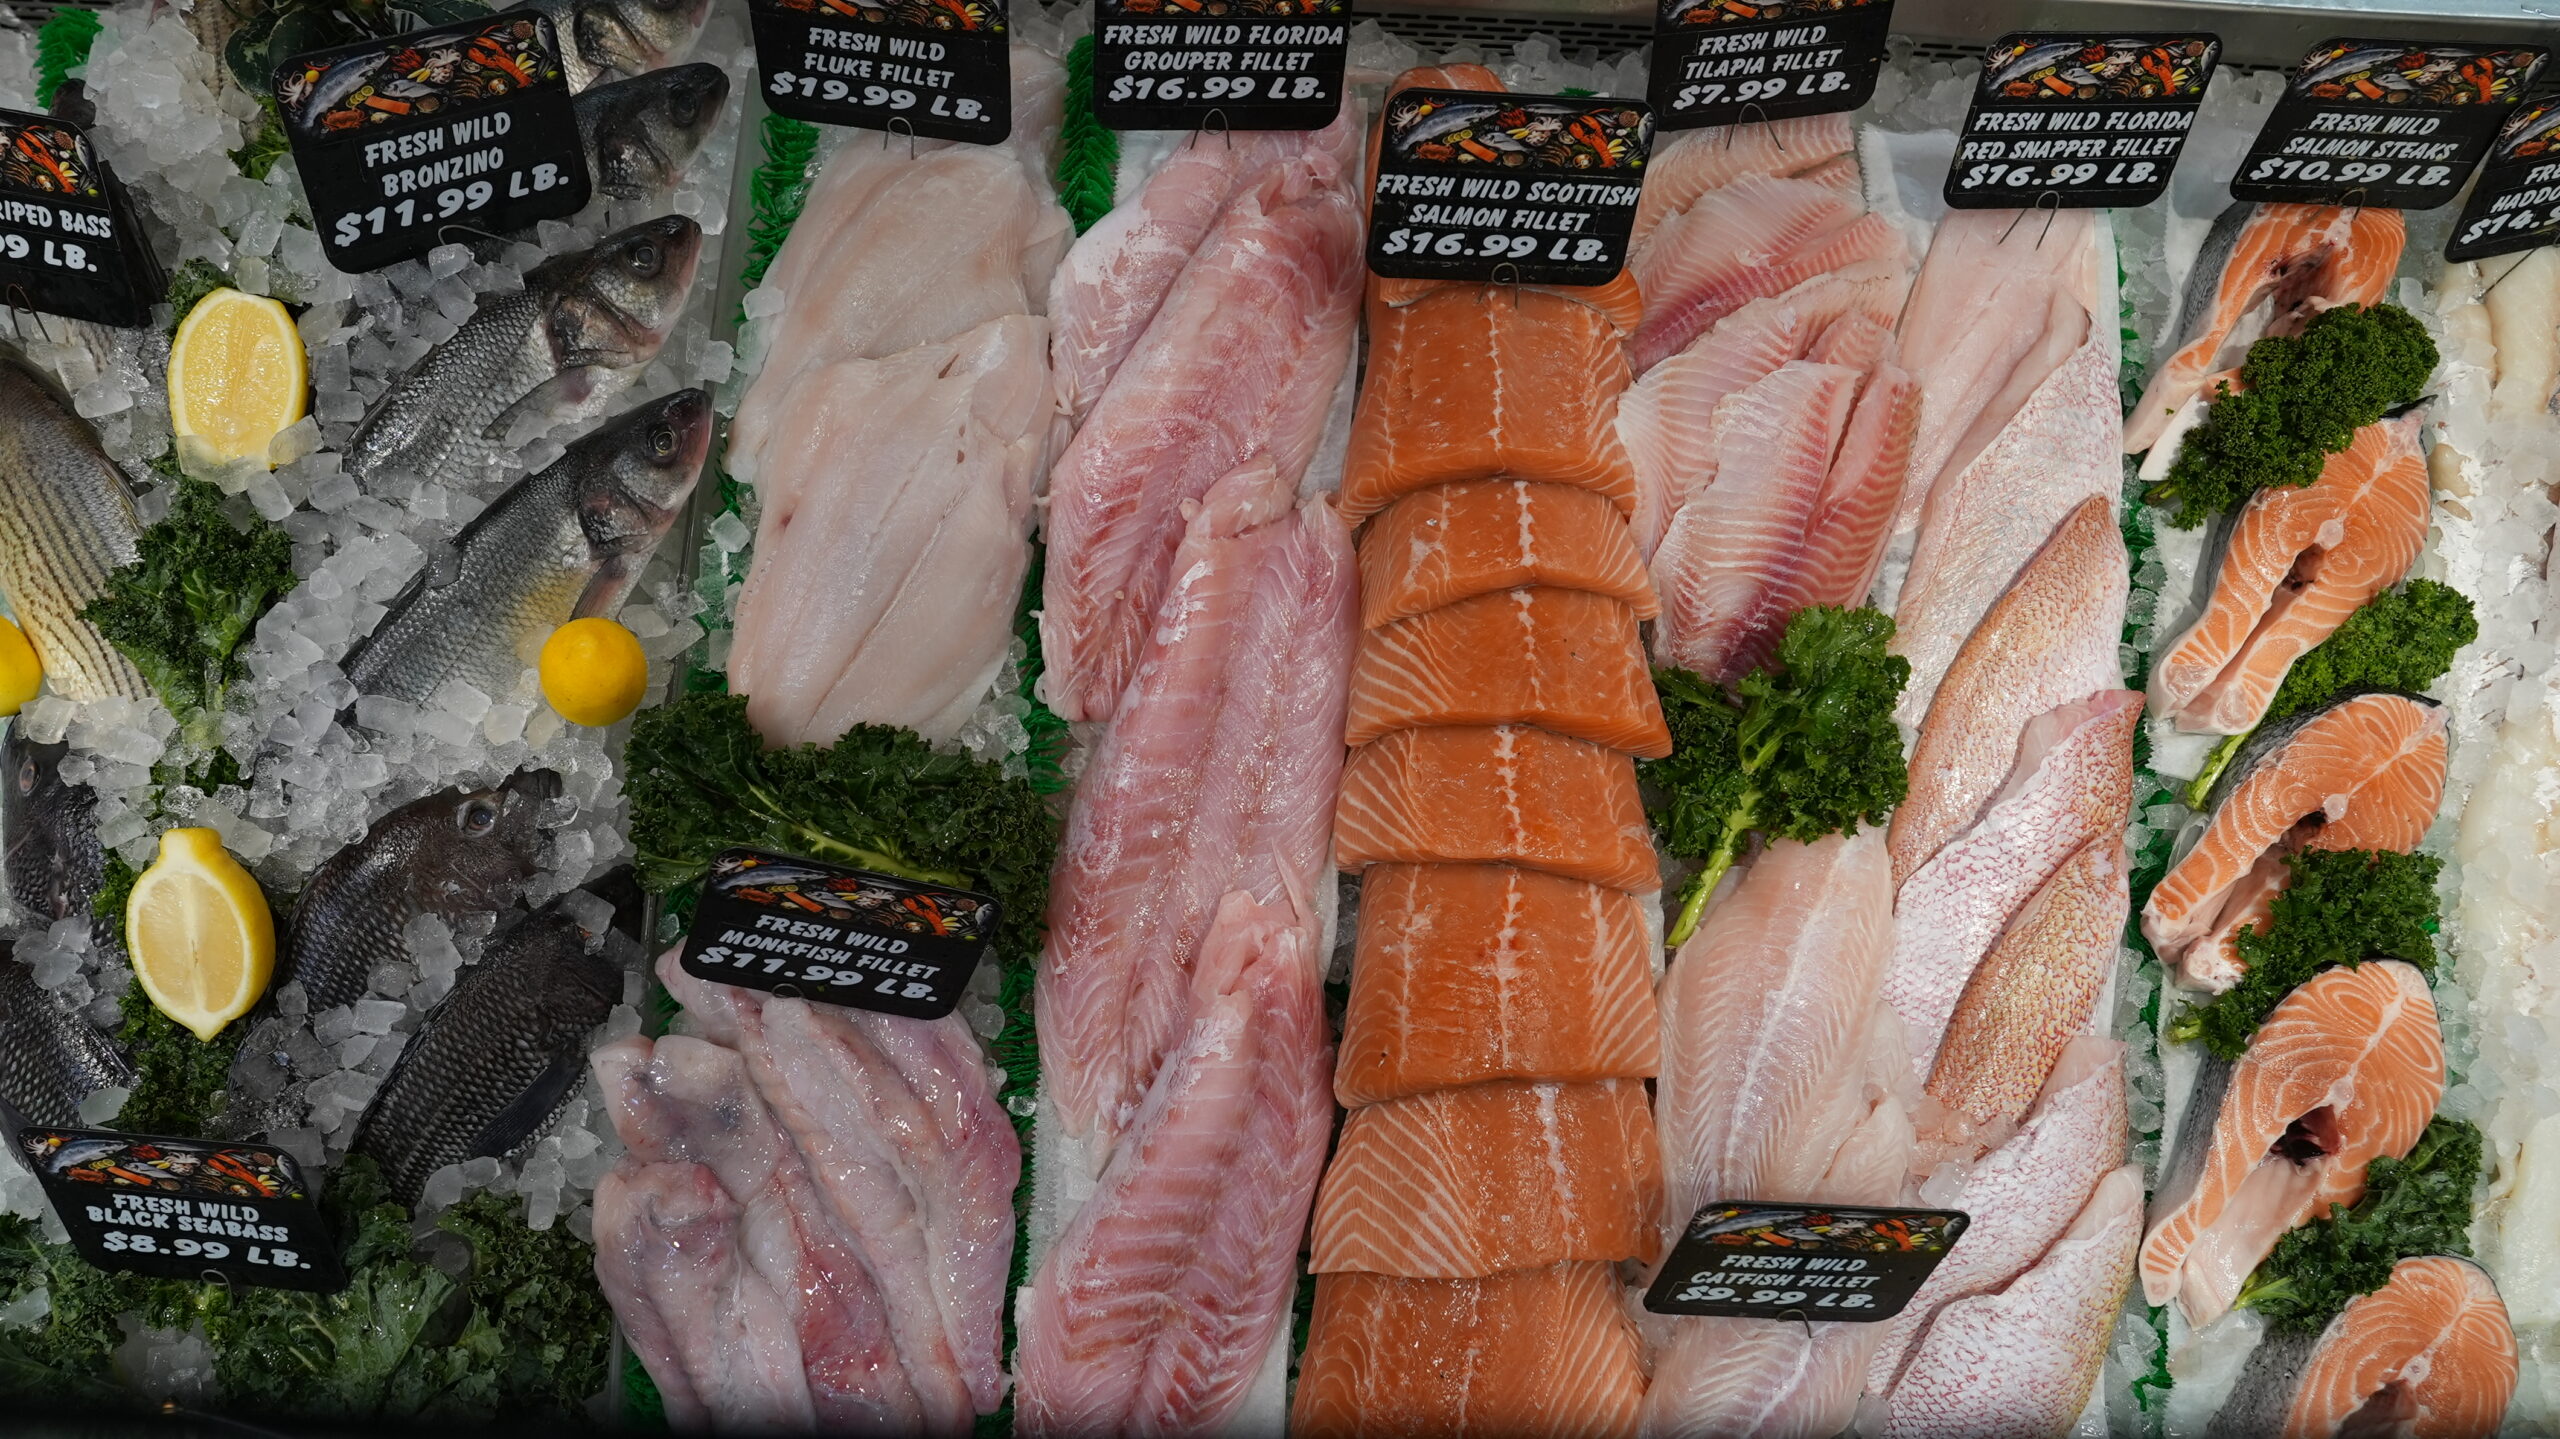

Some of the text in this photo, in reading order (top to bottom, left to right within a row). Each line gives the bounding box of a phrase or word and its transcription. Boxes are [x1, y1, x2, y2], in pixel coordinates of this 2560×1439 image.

[809, 27, 946, 61] FRESH WILD
[1104, 25, 1344, 45] FRESH WILD FLORIDA
[1698, 25, 1827, 56] FRESH WILD
[804, 52, 955, 89] FLUKE FILLET
[1124, 51, 1314, 71] GROUPER FILLET
[1685, 49, 1843, 80] TILAPIA FILLET
[770, 71, 991, 123] $19.99 LB.
[1108, 75, 1325, 101] $16.99 LB.
[1672, 71, 1851, 110] $7.99 LB.
[1973, 111, 2194, 131] FRESH WILD FLORIDA
[2308, 113, 2440, 135] FRESH WILD
[364, 111, 511, 167] FRESH WILD
[1961, 137, 2182, 160] RED SNAPPER FILLET
[2282, 136, 2459, 160] SALMON STEAKS
[382, 147, 504, 197] BRONZINO
[1961, 162, 2158, 189] $16.99 LB.
[2250, 157, 2451, 186] $10.99 LB.
[334, 163, 569, 247] $11.99 LB.
[1376, 174, 1641, 207] FRESH WILD SCOTTISH
[59, 209, 112, 239] BASS
[1408, 204, 1591, 232] SALMON FILLET
[0, 234, 98, 272] 9 LB.
[1382, 228, 1609, 262] $16.99 LB.
[754, 914, 909, 954] FRESH WILD
[718, 929, 941, 980] MONKFISH FILLET
[697, 946, 938, 1002] $11.99 LB.
[86, 1205, 289, 1242] BLACK SEABASS
[112, 1194, 260, 1223] FRESH WILD
[102, 1230, 311, 1270] $8.99 LB.
[1719, 1255, 1868, 1272] FRESH WILD
[1690, 1271, 1881, 1289] CATFISH FILLET
[1676, 1285, 1877, 1308] $9.99 LB.
